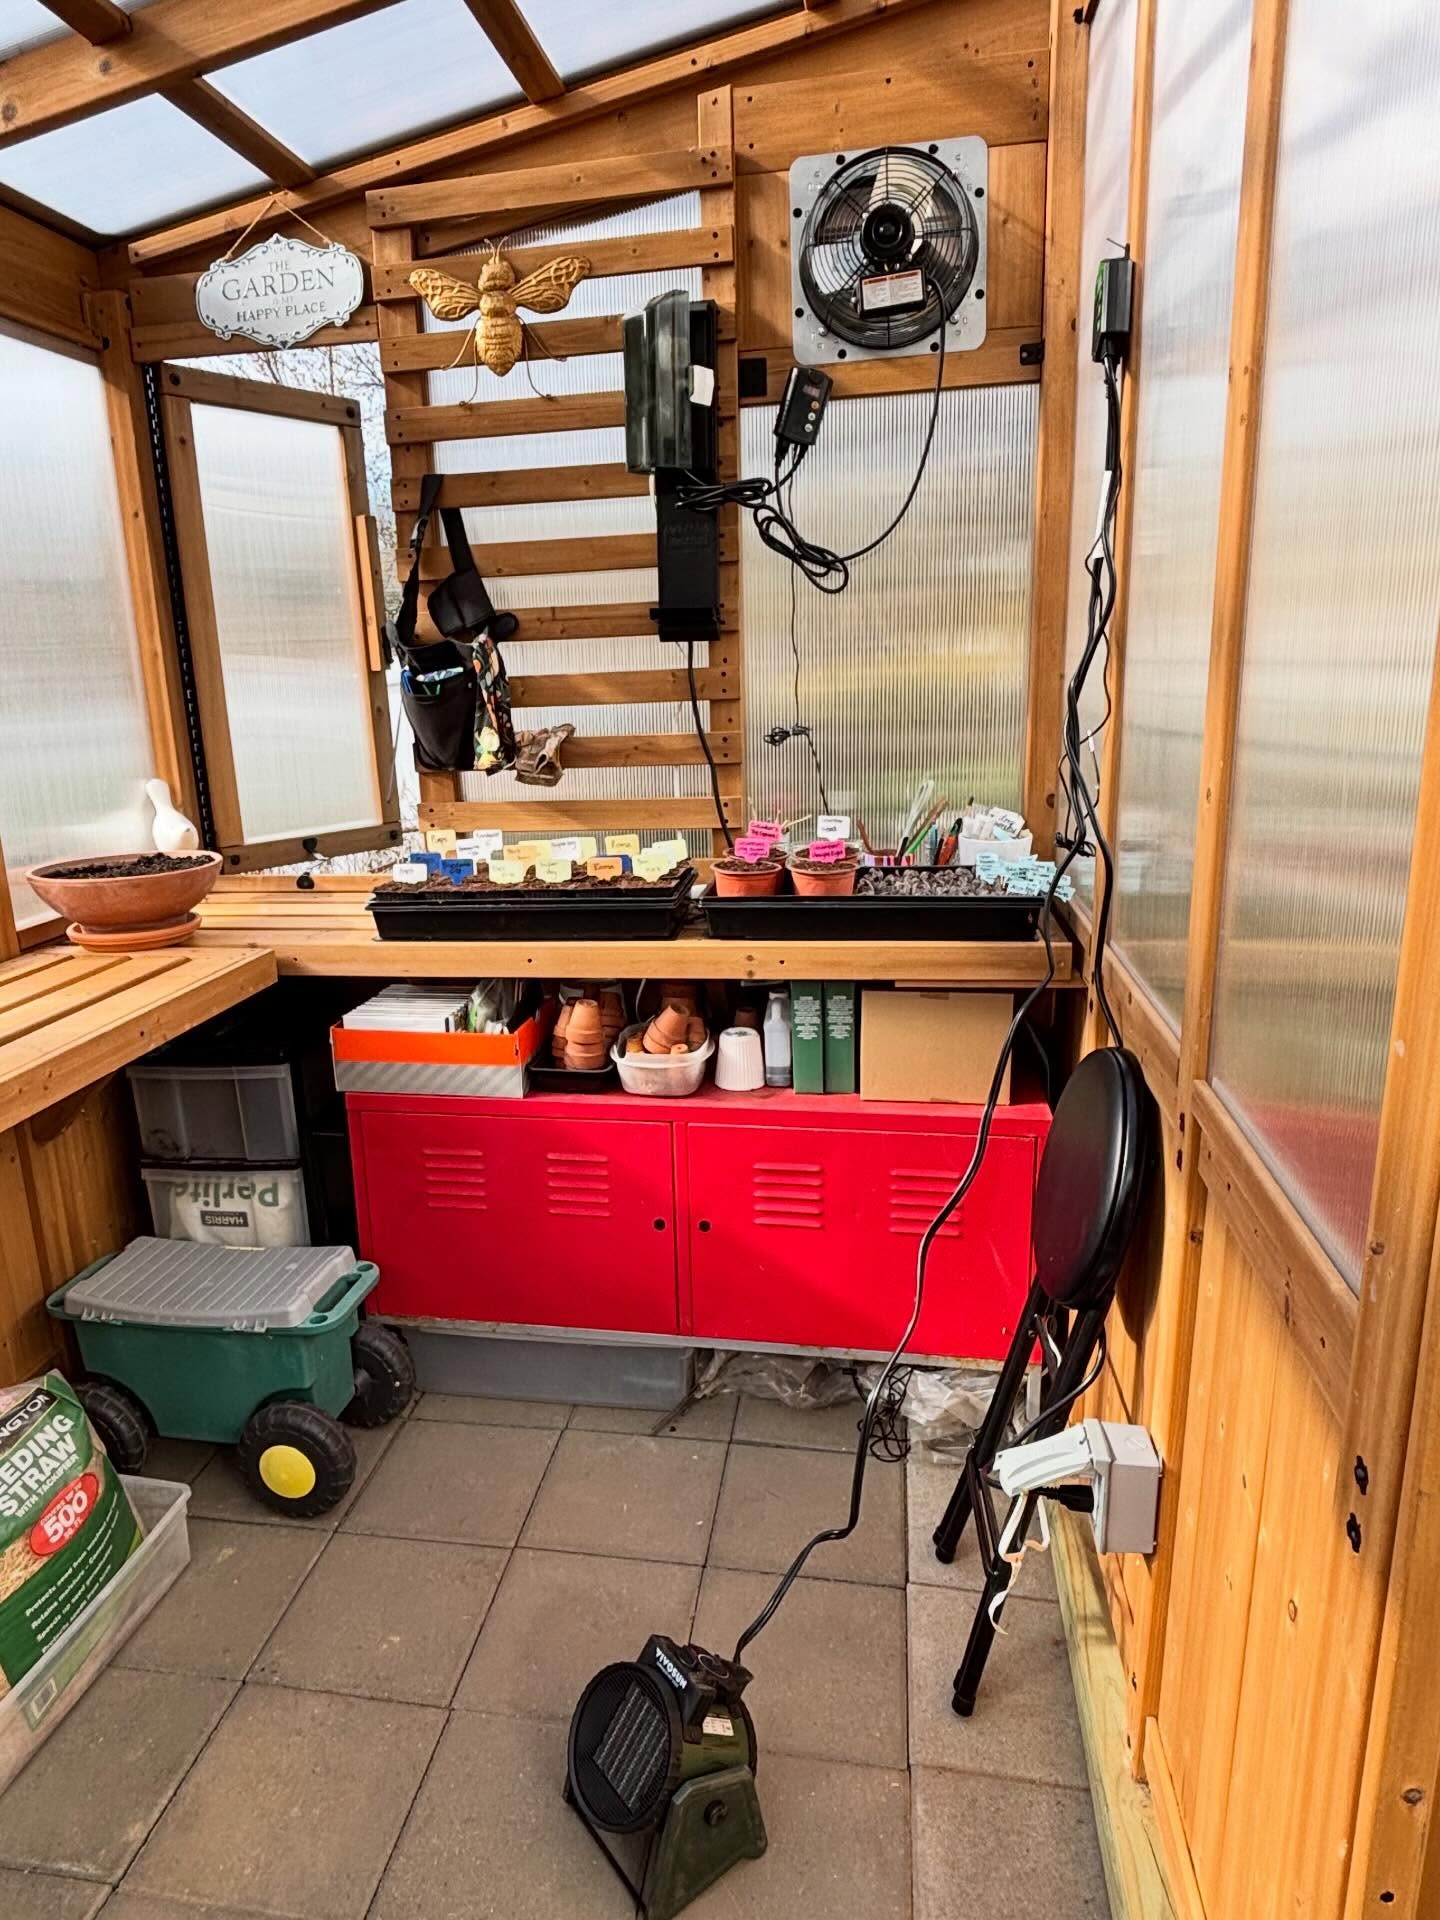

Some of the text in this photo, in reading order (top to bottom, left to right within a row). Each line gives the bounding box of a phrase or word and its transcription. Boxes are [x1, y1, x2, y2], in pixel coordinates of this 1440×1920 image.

[222, 266, 335, 301] GARDEN
[268, 260, 291, 274] THE
[236, 301, 327, 323] HAPPY PLACE
[175, 1175, 280, 1208] Perlite
[204, 1215, 244, 1225] HARRIS
[0, 1433, 76, 1517] STRAW
[15, 1453, 80, 1518] WITH TACKIFIER
[44, 1490, 88, 1543] 500
[655, 1646, 688, 1690] VIVOSUN
